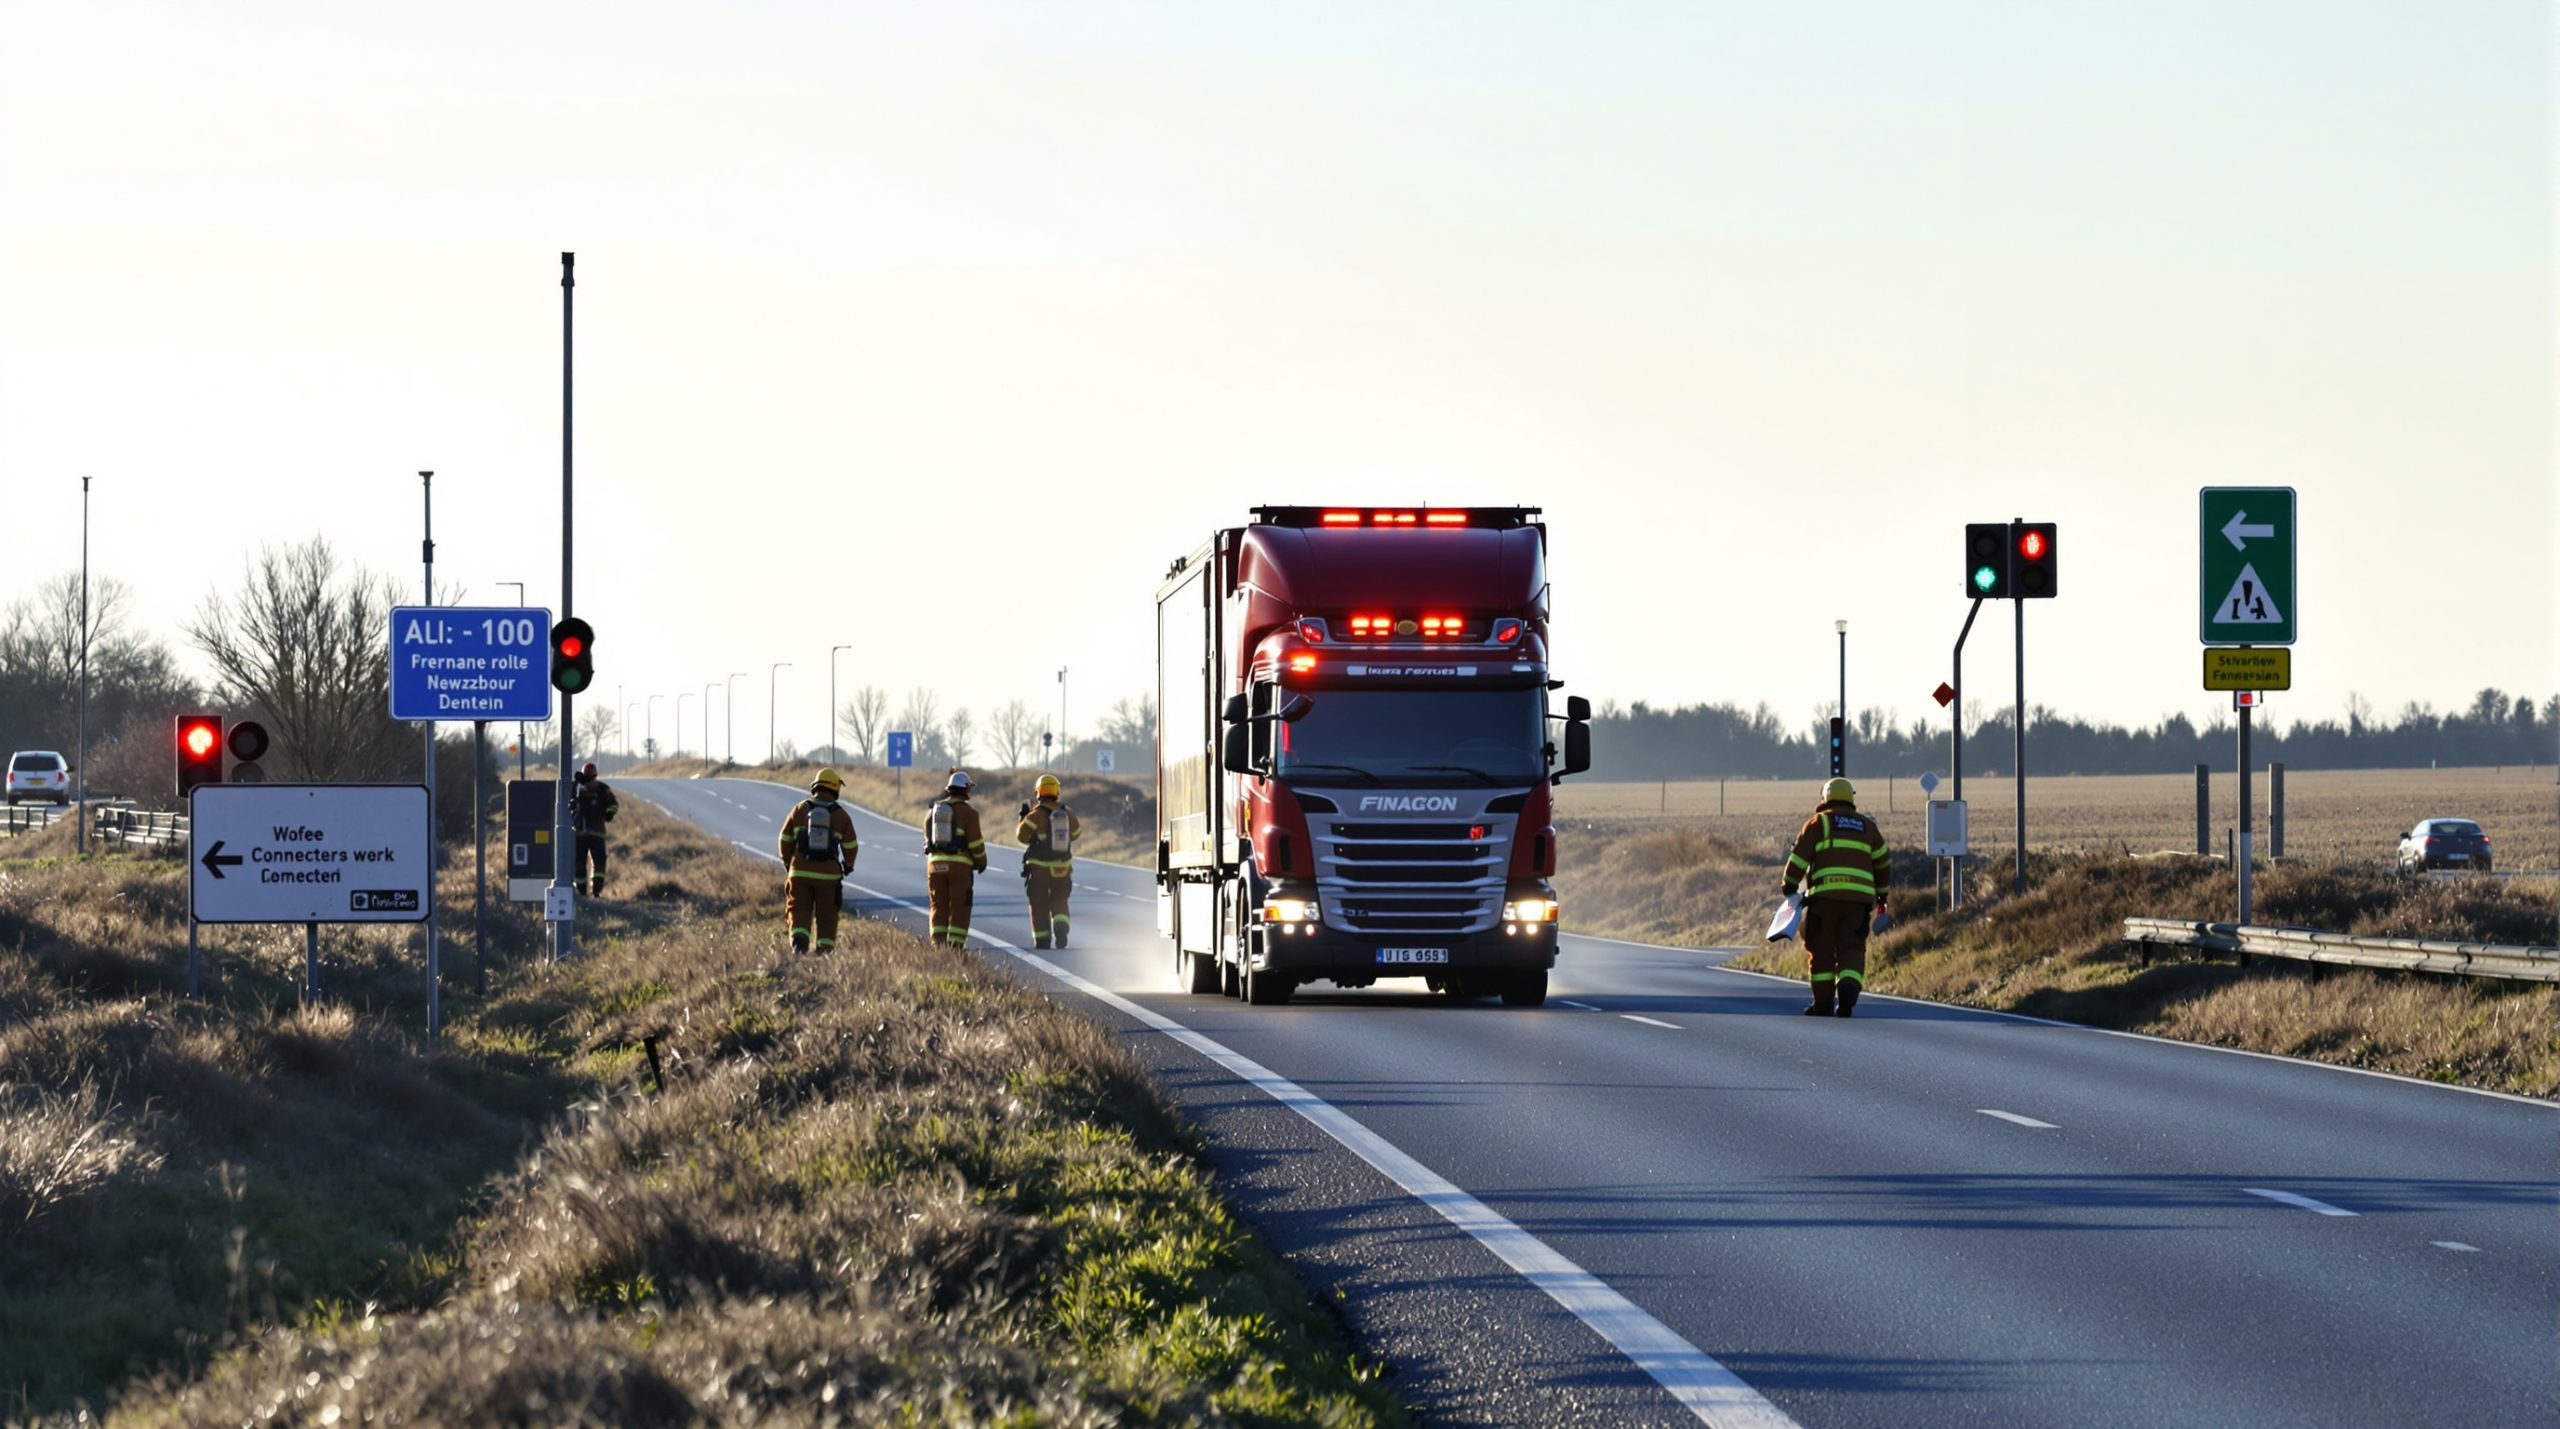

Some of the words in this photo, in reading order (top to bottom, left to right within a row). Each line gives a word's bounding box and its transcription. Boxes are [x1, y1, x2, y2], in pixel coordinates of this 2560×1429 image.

[482, 618, 534, 646] 100
[1360, 796, 1458, 811] FINAGON
[273, 826, 324, 841] Wofee
